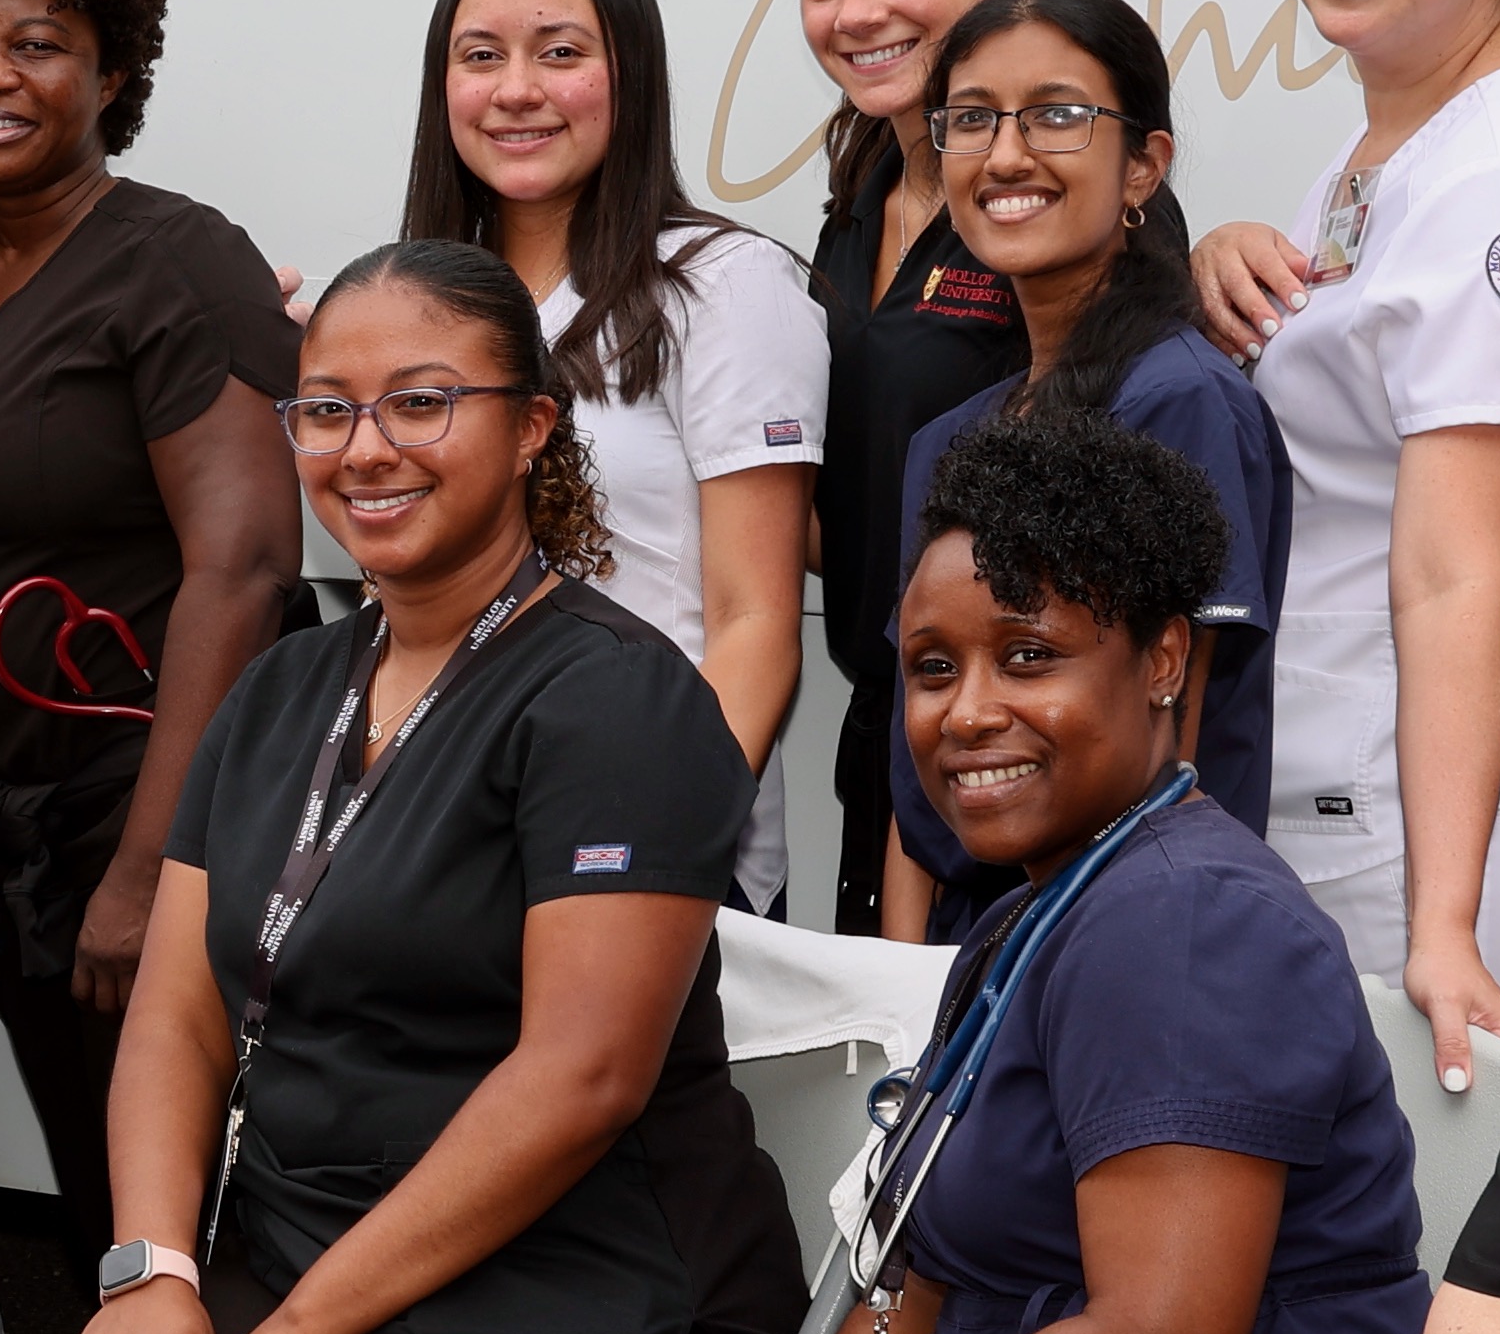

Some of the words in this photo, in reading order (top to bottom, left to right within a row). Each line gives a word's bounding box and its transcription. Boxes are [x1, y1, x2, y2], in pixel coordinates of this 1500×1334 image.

[943, 268, 997, 286] MOLLOY
[470, 599, 503, 640] MOLLOY
[470, 595, 518, 650] UNIVERSITY
[328, 687, 357, 744] UNIVERSITY
[339, 696, 360, 735] MOLLOY
[295, 790, 320, 853] UNIVERSITY
[306, 799, 324, 843] MOLLOY
[327, 798, 357, 840] MOLLOY
[264, 904, 291, 950] MOLLOY
[267, 898, 303, 963] UNIVERSITY
